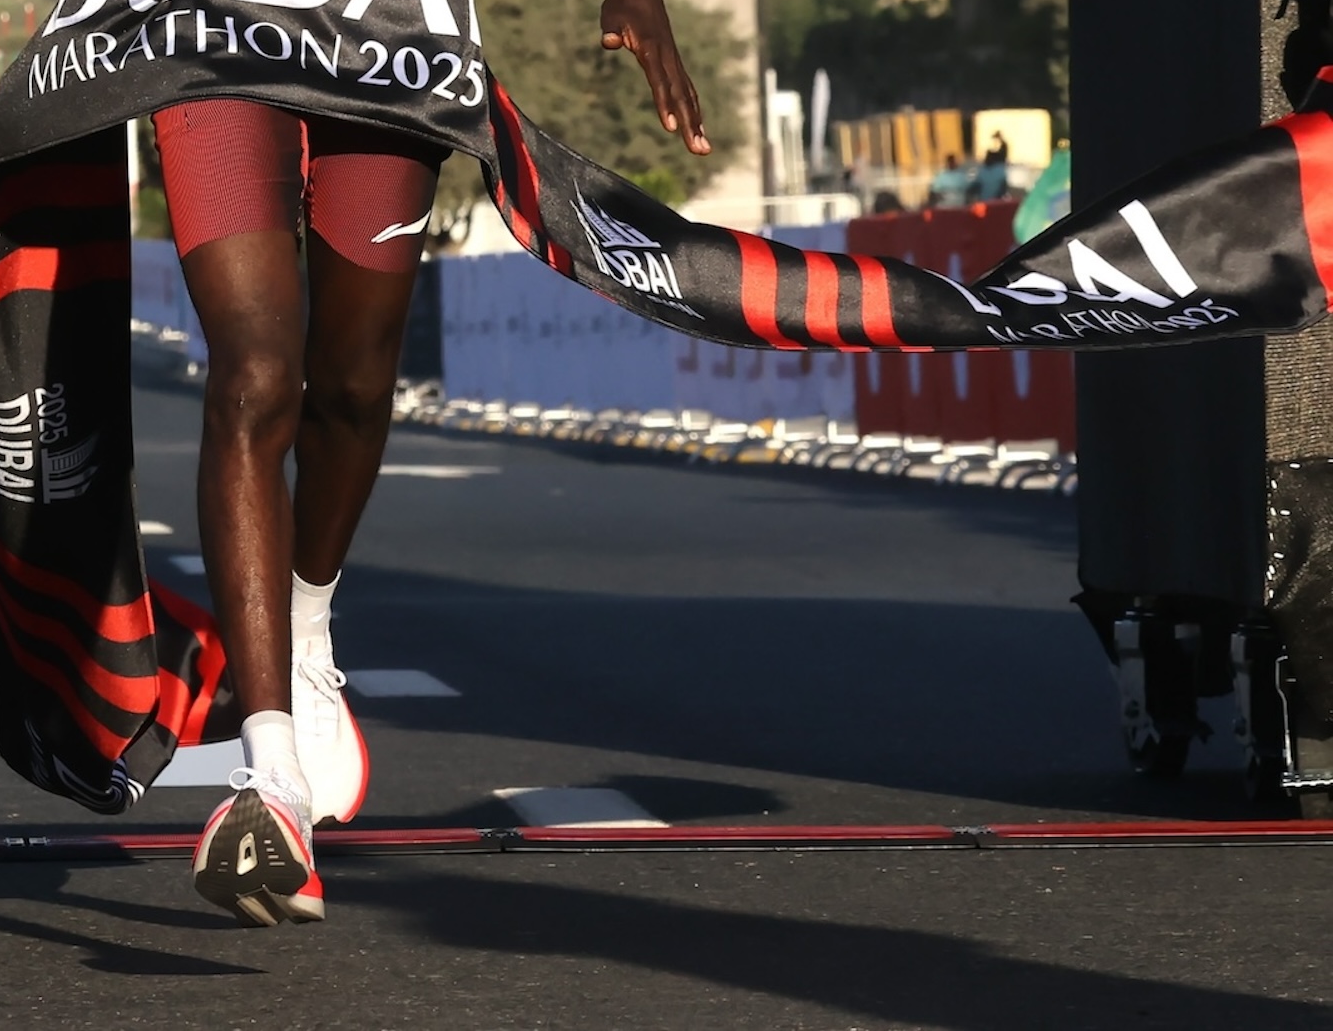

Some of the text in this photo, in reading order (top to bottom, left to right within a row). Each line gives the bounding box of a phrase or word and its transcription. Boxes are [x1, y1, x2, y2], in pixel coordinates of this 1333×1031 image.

[28, 8, 486, 107] MARATHON 2025
[34, 382, 68, 444] 2025
